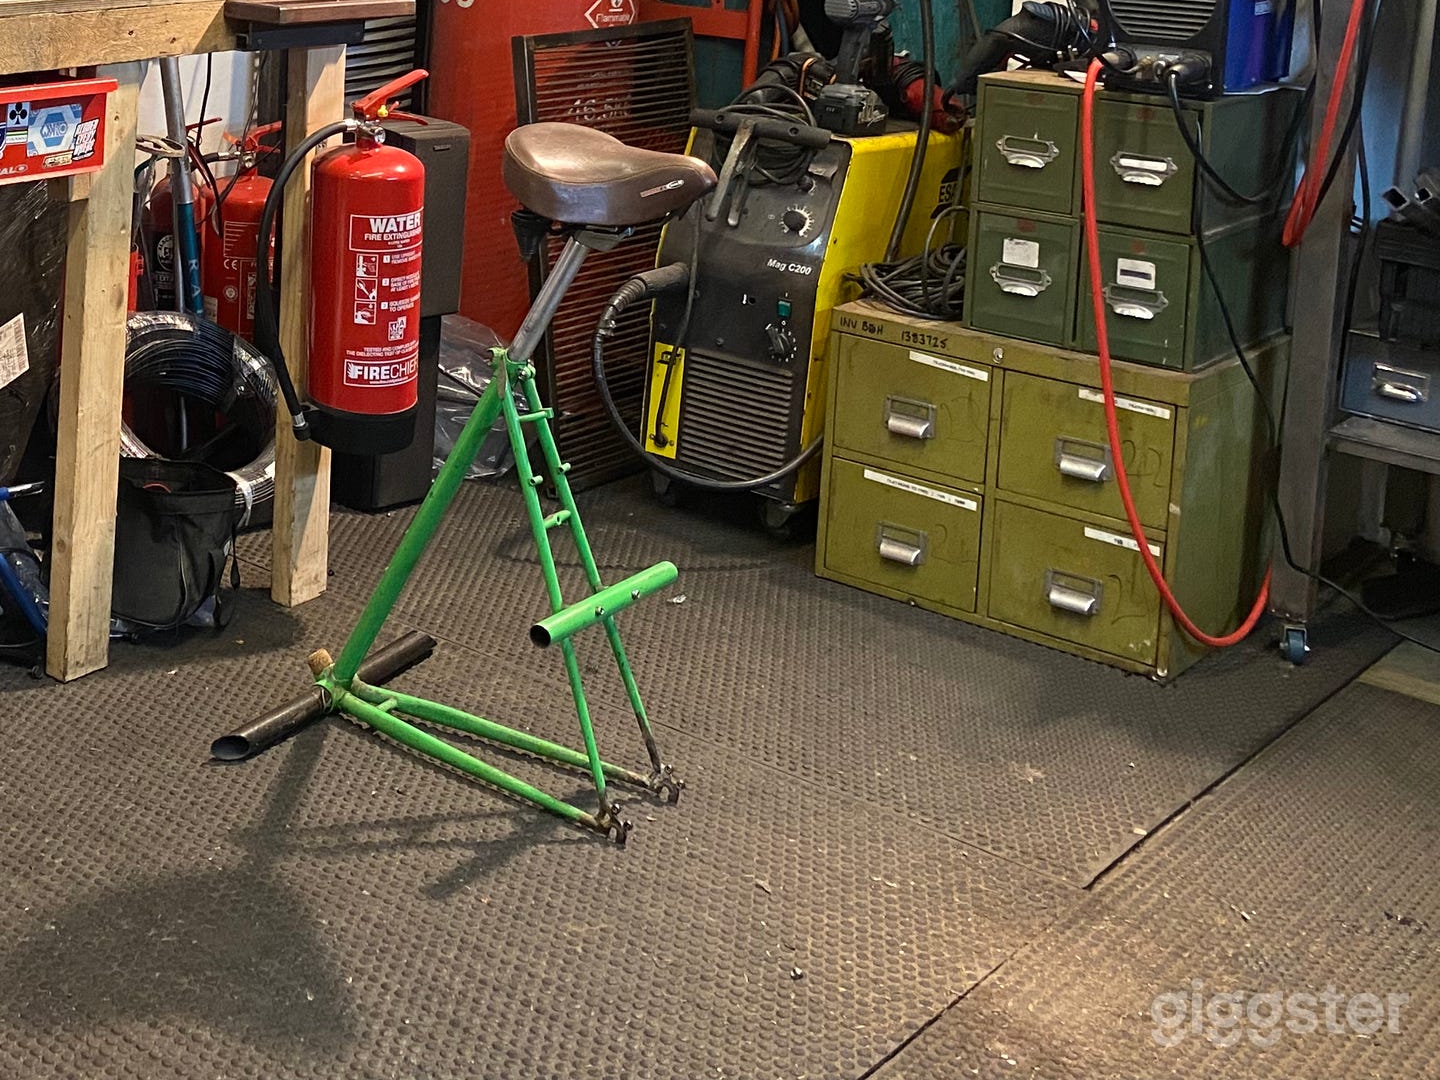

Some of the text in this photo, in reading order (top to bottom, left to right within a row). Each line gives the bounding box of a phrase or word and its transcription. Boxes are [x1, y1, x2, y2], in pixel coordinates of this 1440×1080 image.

[369, 212, 421, 233] WATER
[364, 233, 382, 241] FIRE
[223, 258, 238, 271] CE
[766, 258, 812, 275] Mag C200
